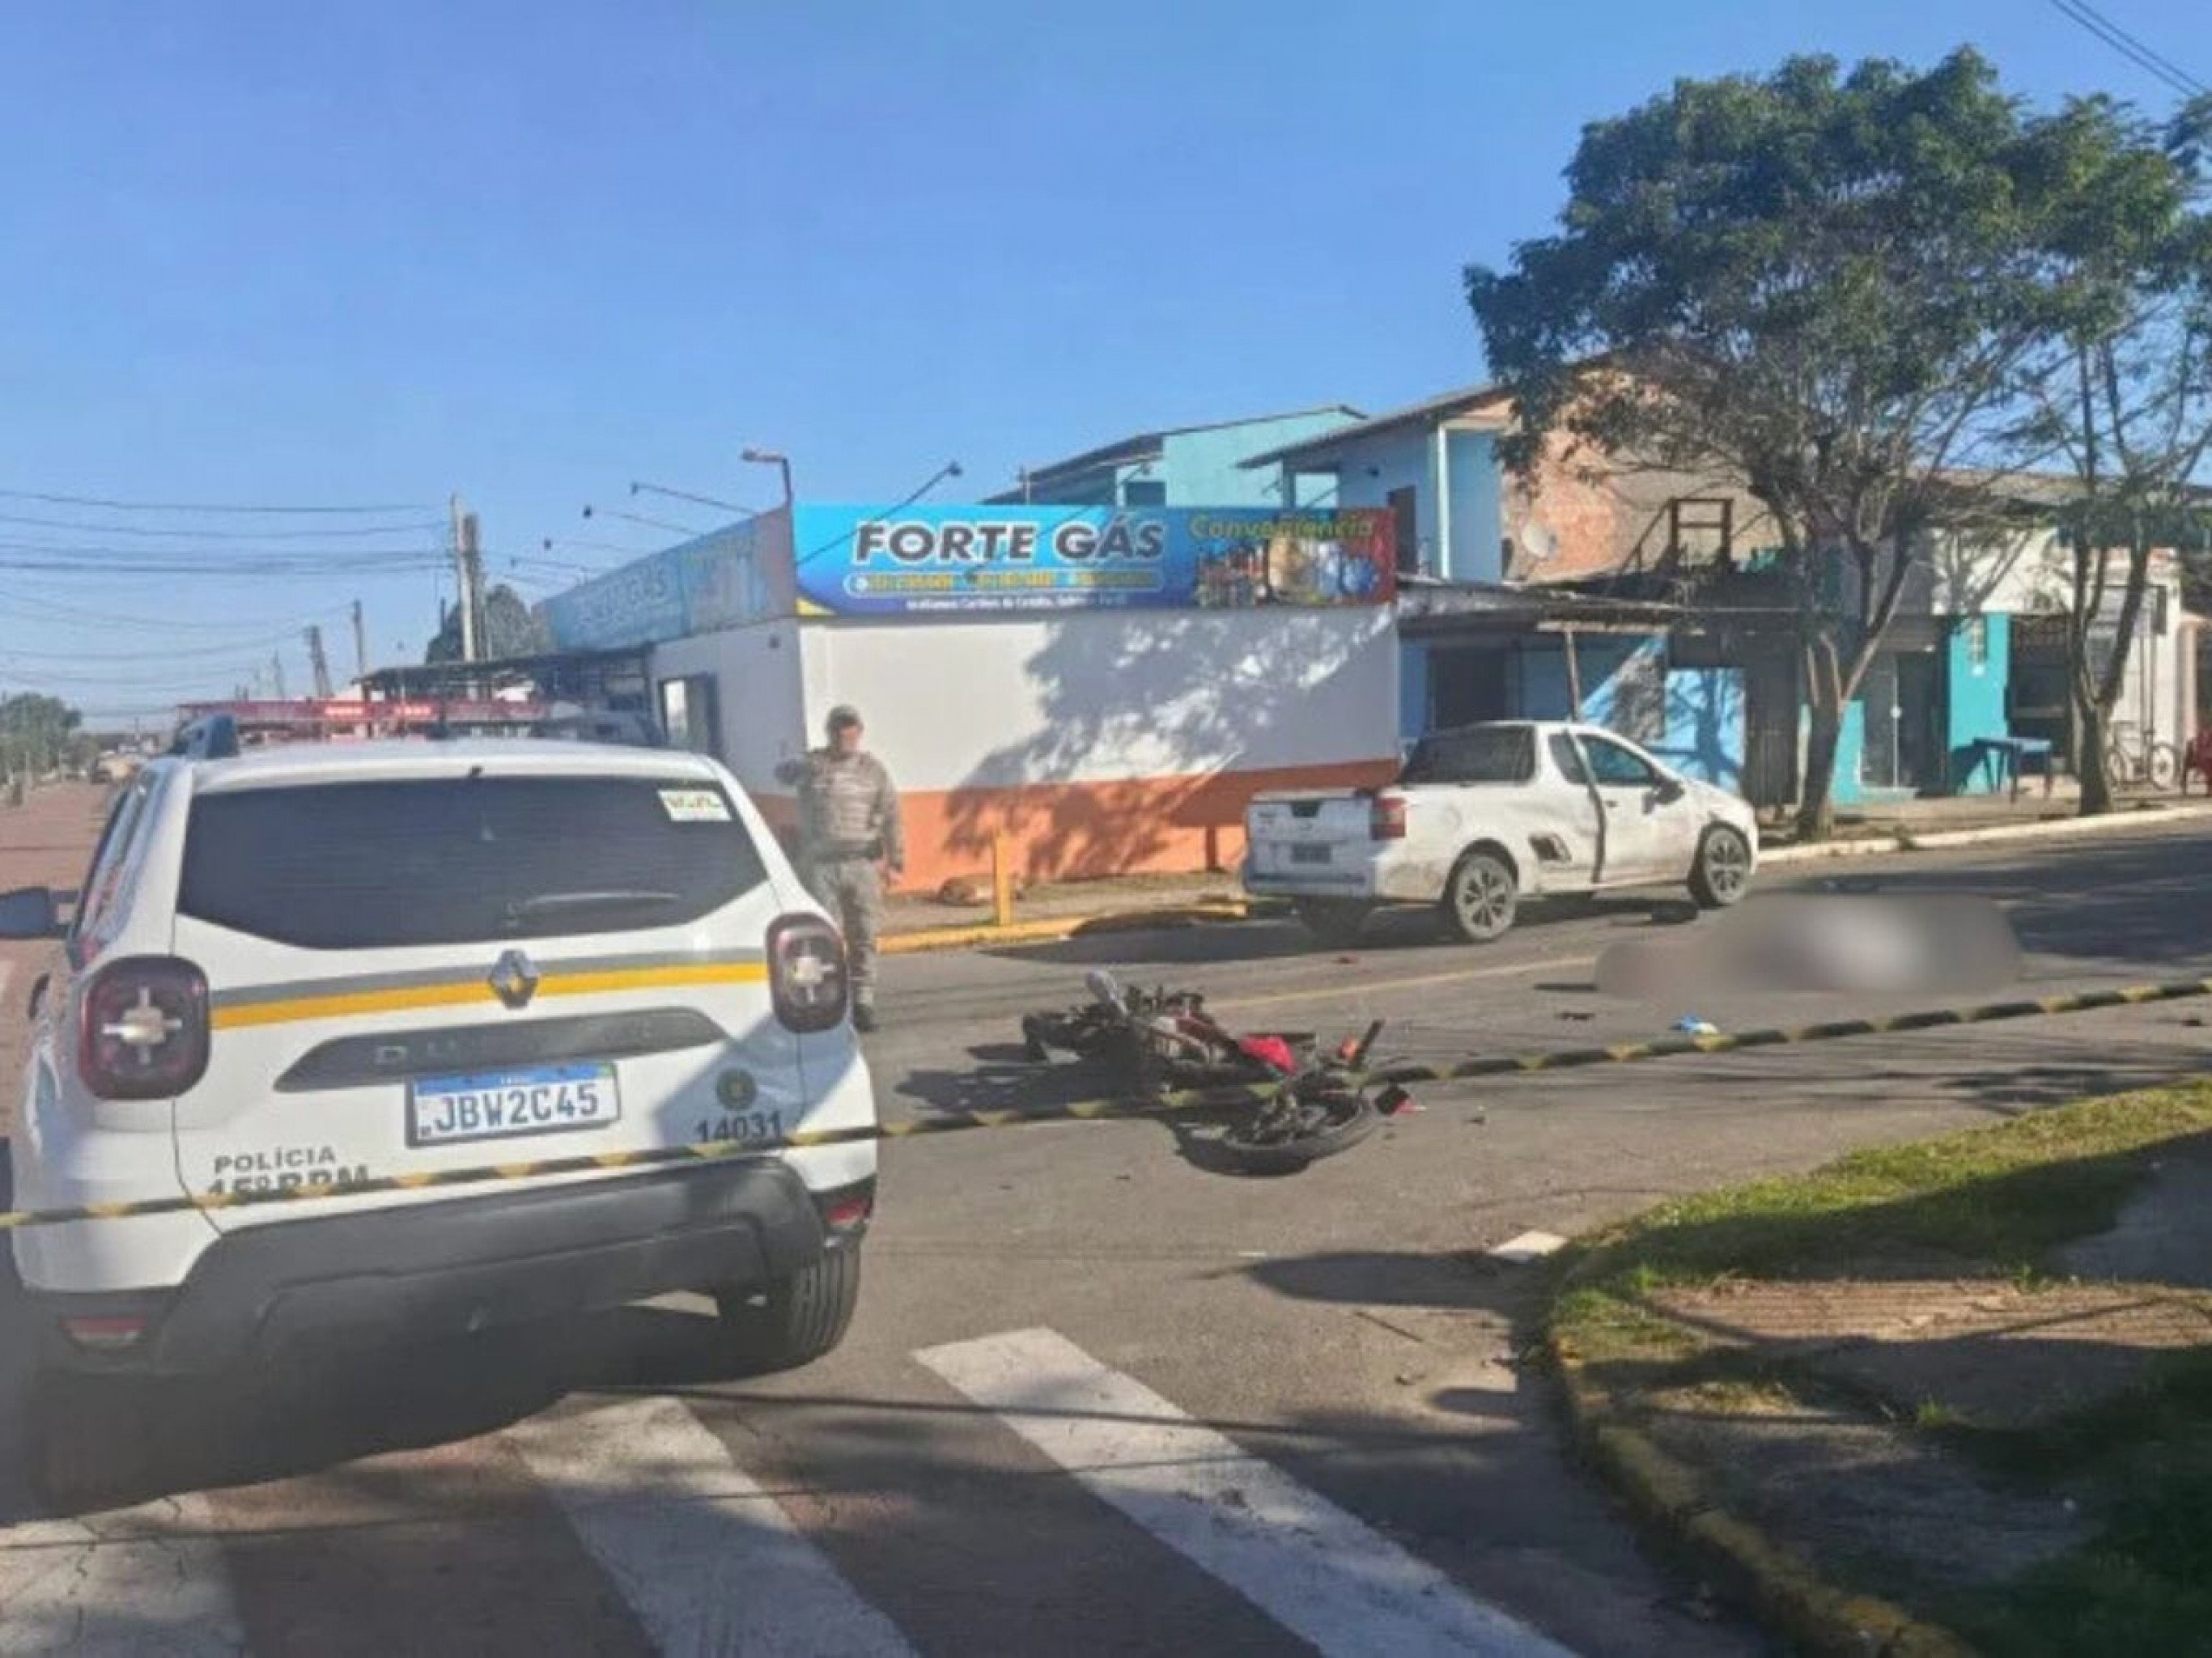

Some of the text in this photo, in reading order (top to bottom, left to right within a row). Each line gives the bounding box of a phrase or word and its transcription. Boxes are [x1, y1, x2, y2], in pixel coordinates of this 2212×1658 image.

[855, 510, 1165, 562] FORTE GÁS
[434, 1082, 599, 1132] JBW2C45
